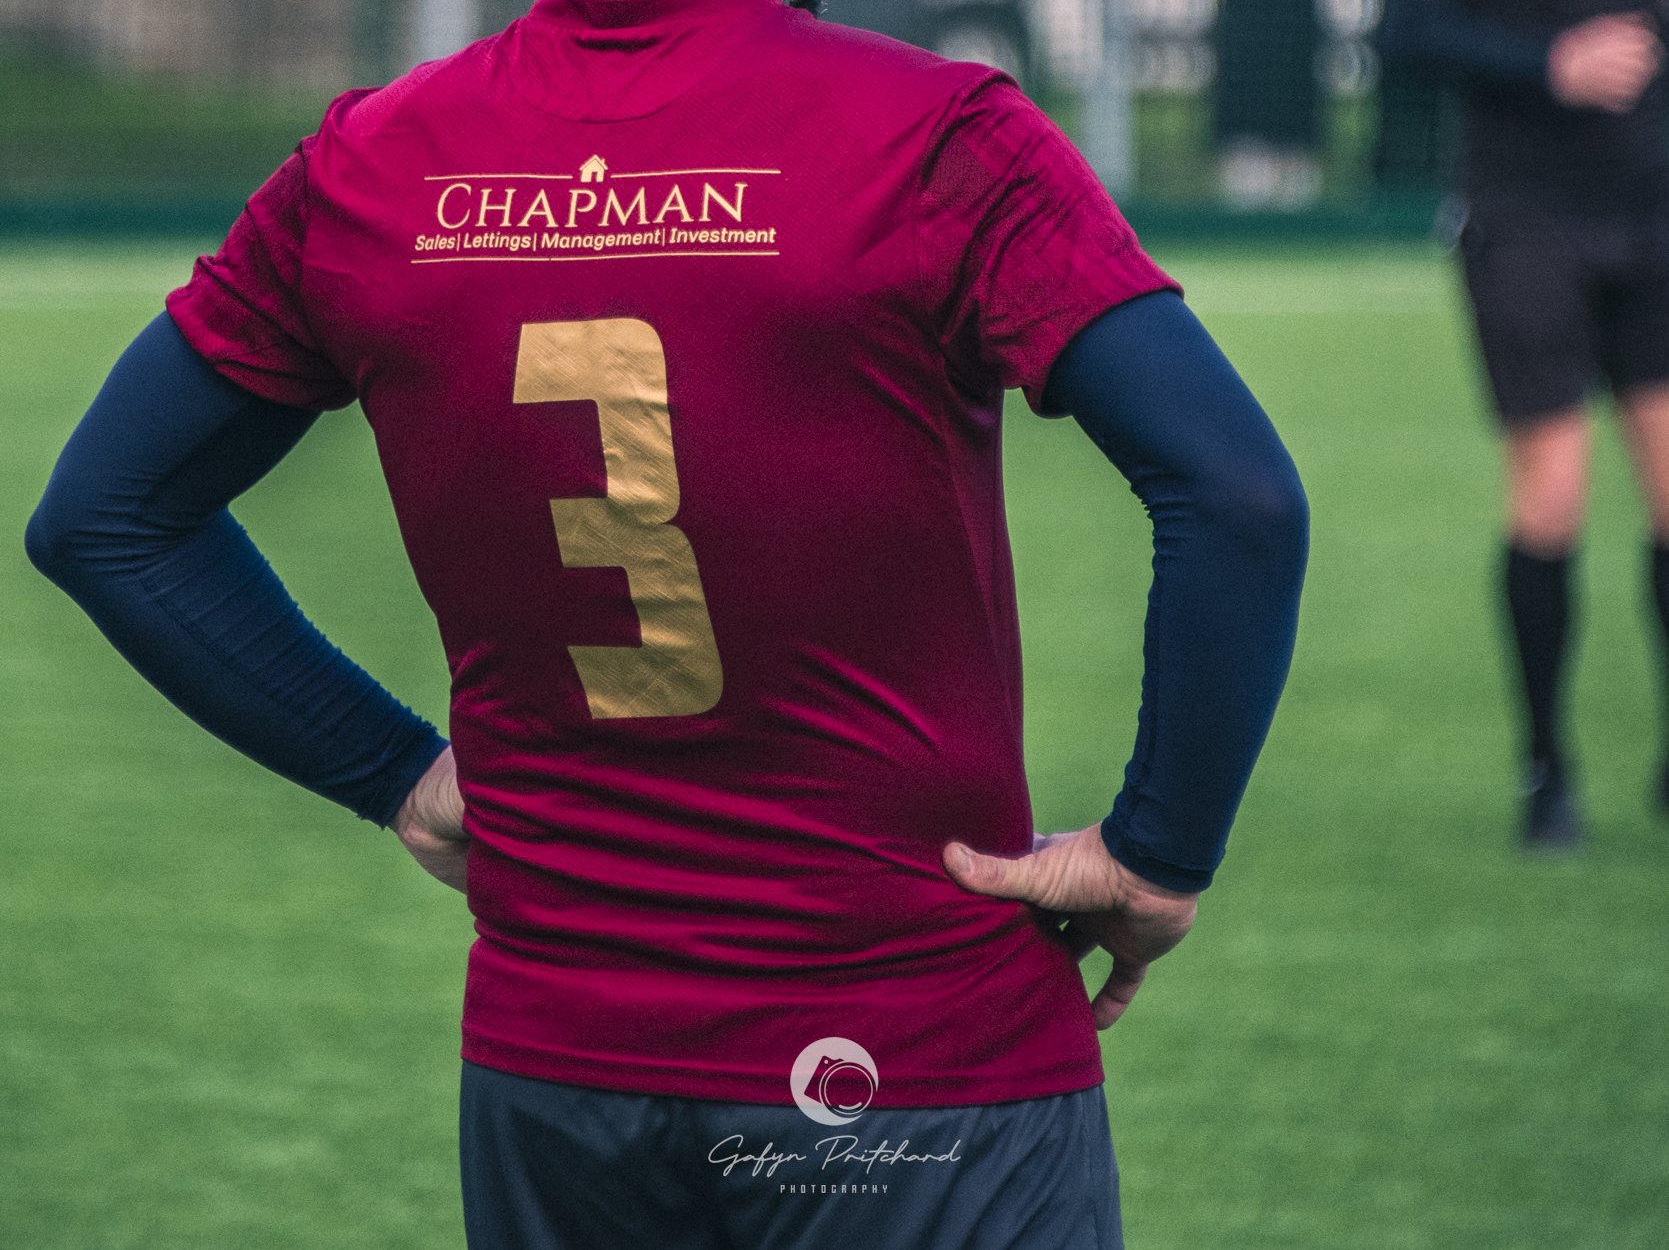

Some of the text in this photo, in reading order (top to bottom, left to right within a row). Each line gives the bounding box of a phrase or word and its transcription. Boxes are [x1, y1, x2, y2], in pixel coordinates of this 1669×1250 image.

[436, 182, 748, 230] CHAPMAN
[669, 226, 777, 244] Investment
[512, 317, 724, 720] 3
